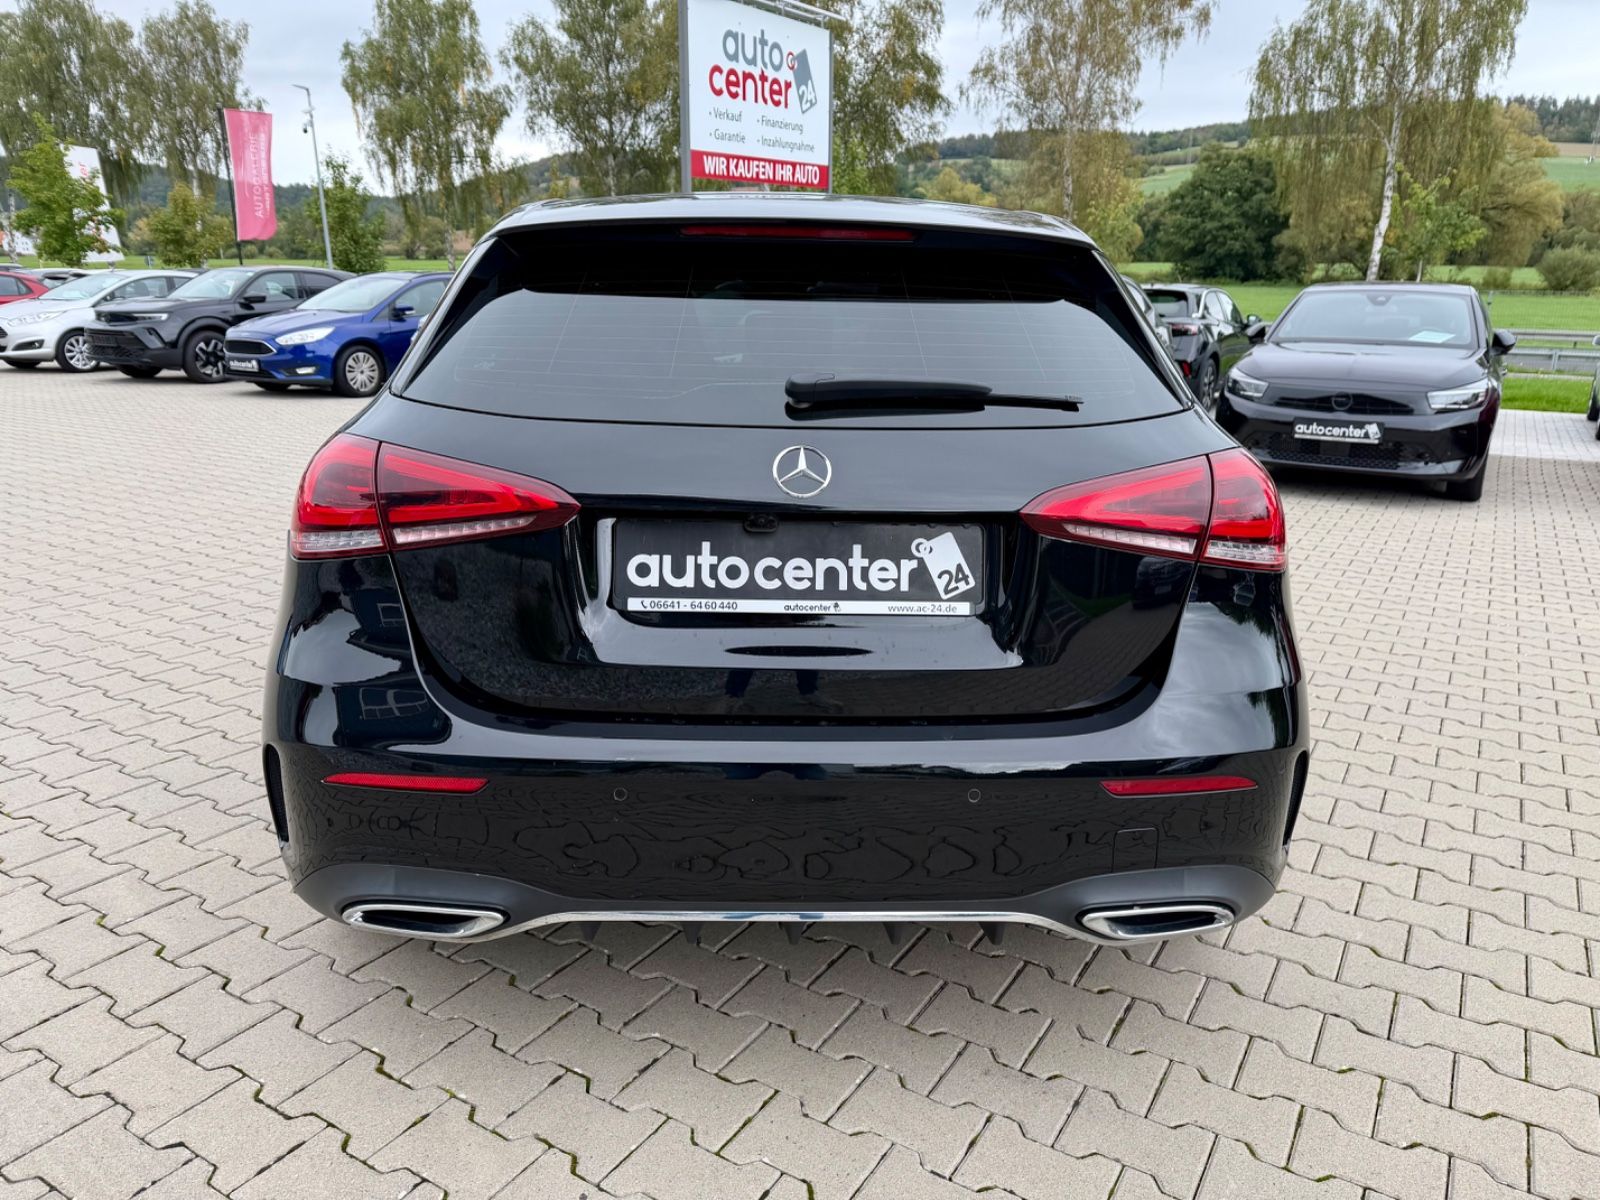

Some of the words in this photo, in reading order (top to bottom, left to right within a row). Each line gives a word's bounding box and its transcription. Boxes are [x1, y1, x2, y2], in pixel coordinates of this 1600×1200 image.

[722, 28, 784, 72] auto
[708, 64, 792, 109] center
[798, 80, 816, 110] 24
[713, 108, 743, 123] Verkauf
[760, 115, 804, 135] Finanzierung
[714, 128, 746, 144] Garantie
[761, 135, 815, 153] Inzahlungnahme
[703, 154, 727, 176] WIR
[729, 157, 774, 180] KAUFEN
[775, 163, 793, 182] IHR
[794, 165, 820, 185] AUTO
[1295, 421, 1367, 438] autocenter
[626, 540, 918, 592] autocenter
[936, 563, 971, 597] 24
[649, 600, 681, 610] 06641
[783, 602, 831, 612] autocenter
[887, 603, 958, 614] www.ac-24.de
